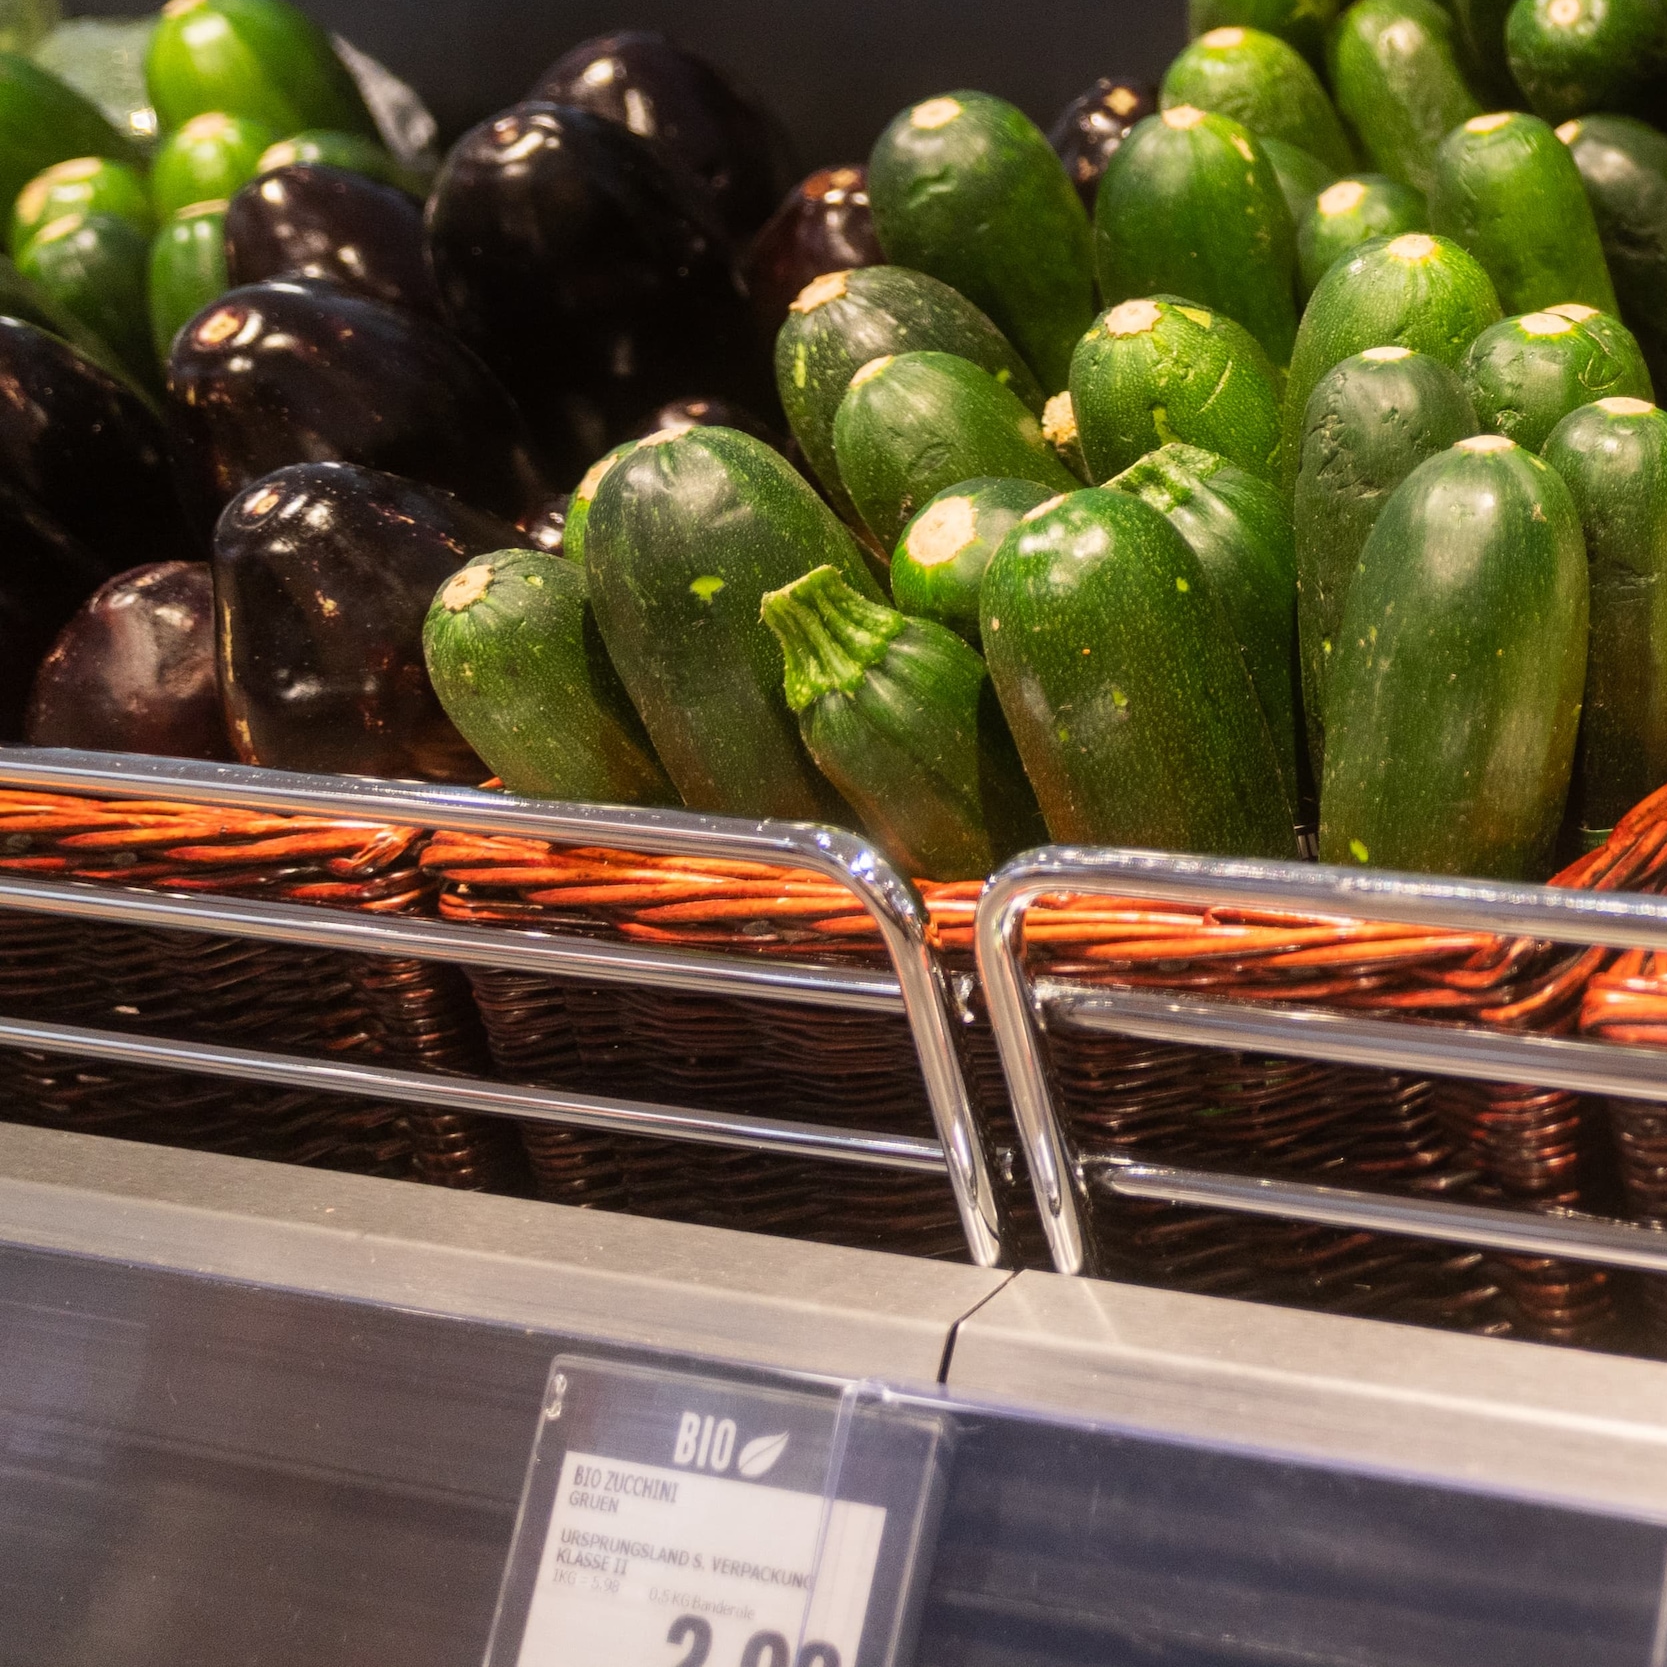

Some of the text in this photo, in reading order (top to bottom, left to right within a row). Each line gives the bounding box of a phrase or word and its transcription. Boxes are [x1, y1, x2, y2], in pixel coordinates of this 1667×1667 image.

[673, 1411, 737, 1471] BIO
[569, 1490, 619, 1513] GRUEN
[573, 1464, 679, 1504] BIO ZUCCHINI
[556, 1547, 629, 1576] KLASSE II
[560, 1528, 690, 1567] URSPRUNGSLAND
[693, 1552, 705, 1570] S.
